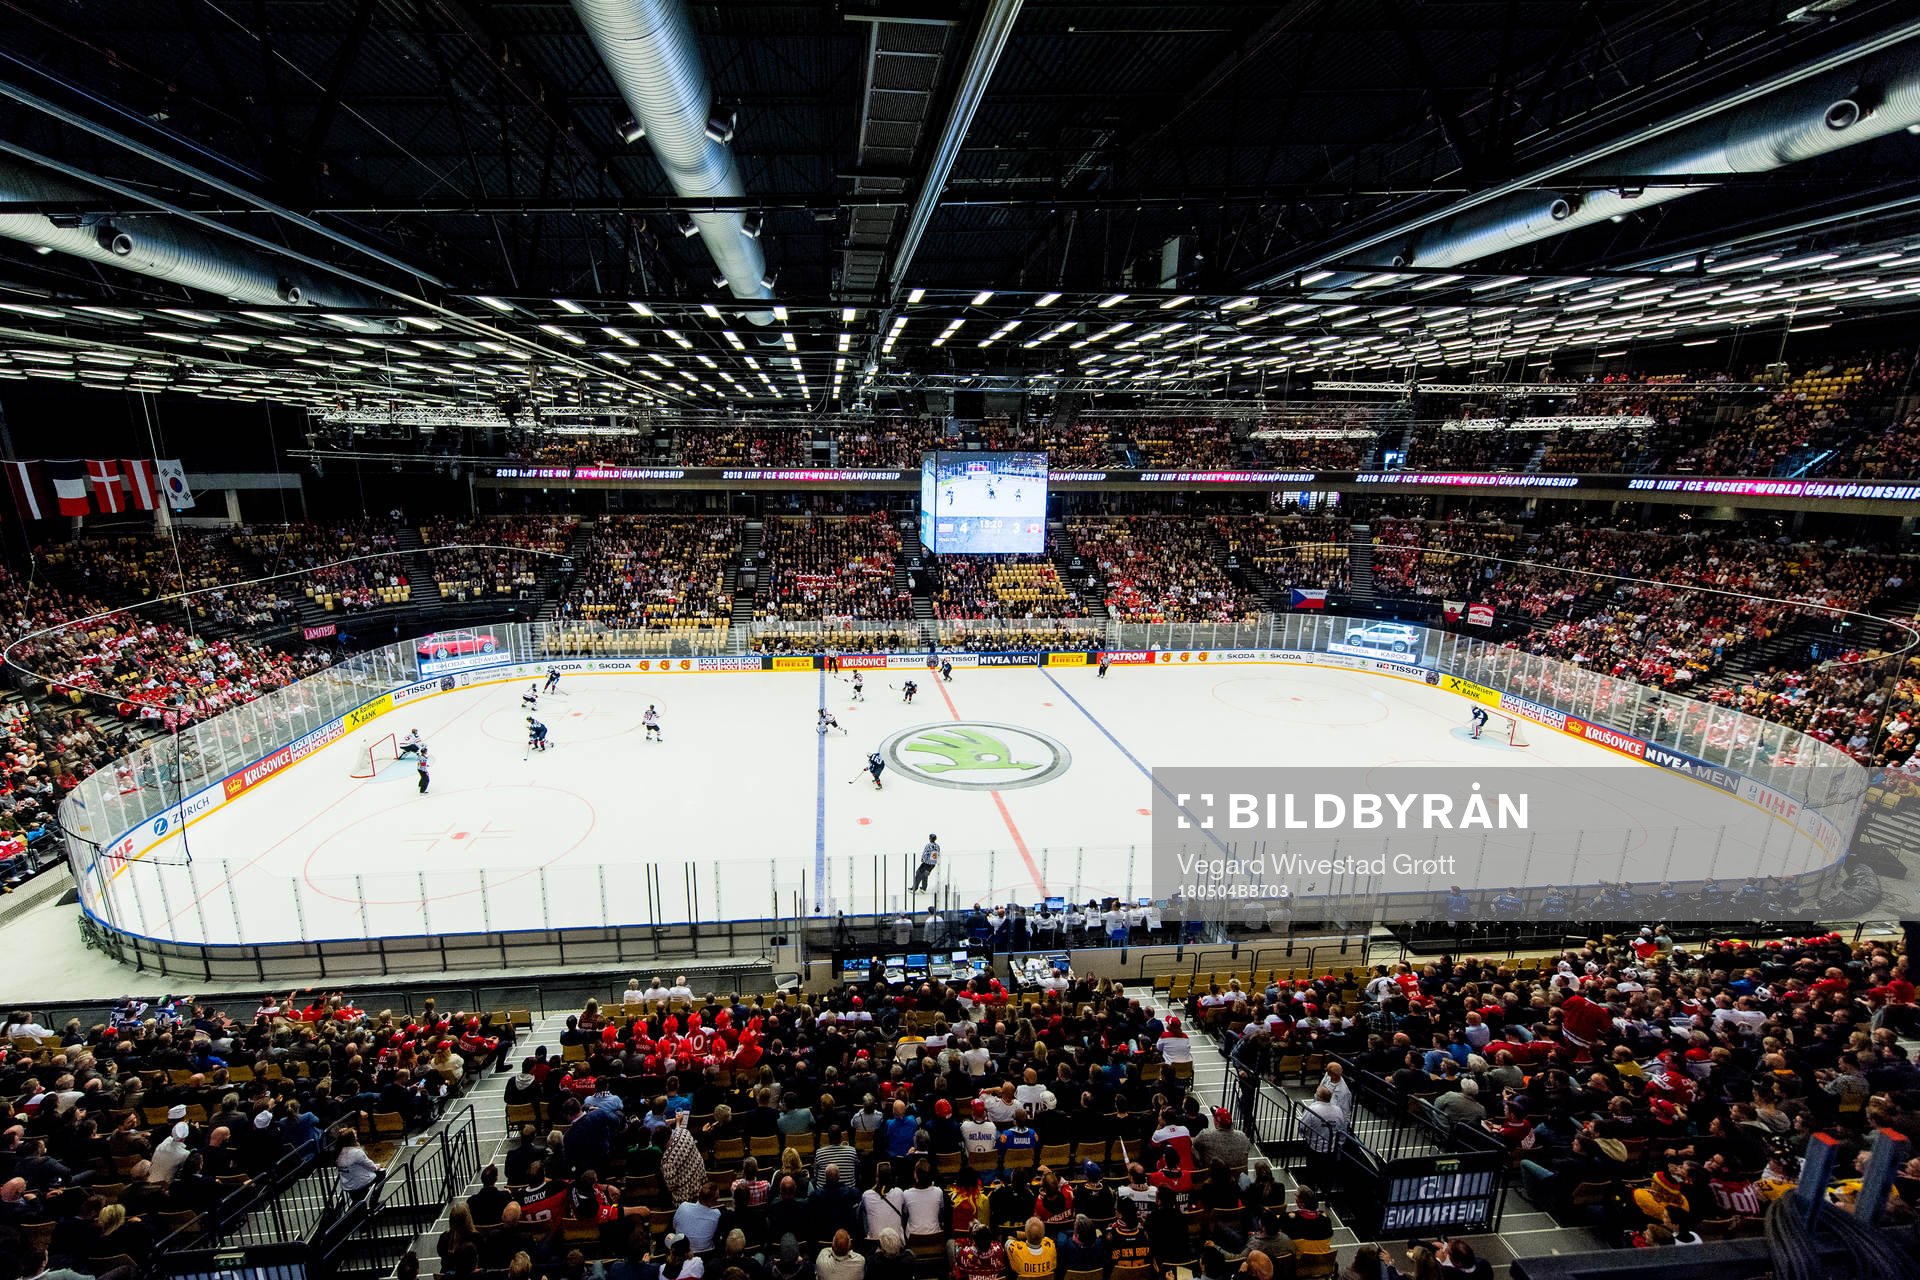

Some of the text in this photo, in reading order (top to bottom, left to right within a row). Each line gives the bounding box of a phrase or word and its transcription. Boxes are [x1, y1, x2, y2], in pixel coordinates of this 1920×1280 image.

[496, 469, 685, 479] 2018 IHF ICE HOEY WORLD CHAMPIONSHIP
[723, 471, 901, 481] 2018 IIHF ICE HOCKEY WORLD CHAMPIONSHIP
[1049, 472, 1107, 481] CHAMPIONSHIP
[1141, 472, 1315, 482] 2018 IIHF ICE HOCKEY WORLD CHAMPIONSHIP
[1356, 474, 1579, 488] 2018 IIHF ICE HOCKEY WORLD CHAMPIONSHIP
[1628, 479, 1920, 501] 2018 IIHF ICE HOCKEY WORLD CHAMPIONSHIP
[842, 656, 886, 667] KRUŠOVICE
[979, 655, 1038, 666] NIVEA MEN
[1107, 652, 1147, 661] PATRON
[1391, 664, 1425, 677] TISSOT
[406, 681, 438, 696] TISSOT
[1462, 687, 1481, 700] BANK
[1463, 680, 1494, 696] Raiffeisen
[359, 697, 386, 714] Raiffeisen
[1502, 693, 1521, 706] LIQUI
[1522, 700, 1542, 713] LIQUI
[1501, 701, 1520, 713] MOLY
[361, 710, 377, 722] BANK
[1521, 708, 1541, 721] MOLY
[1543, 708, 1565, 722] LIQUI
[328, 718, 343, 732] LIQUI
[1542, 717, 1564, 731] MOLY
[310, 727, 327, 742] LIQUI
[329, 727, 345, 741] MOLY
[1584, 725, 1643, 756] KRUŠOVICE
[291, 738, 310, 752] LIQUI
[312, 736, 329, 751] MOLY
[293, 747, 311, 761] MOLY
[243, 752, 291, 787] KRUŠOVICE
[1645, 749, 1739, 791] NIVEA MEN
[172, 796, 210, 824] ZURICH
[1758, 789, 1797, 819] IIHF
[1816, 823, 1838, 847] IIHF
[688, 1034, 704, 1053] 10
[1024, 1261, 1051, 1273] DIETER
